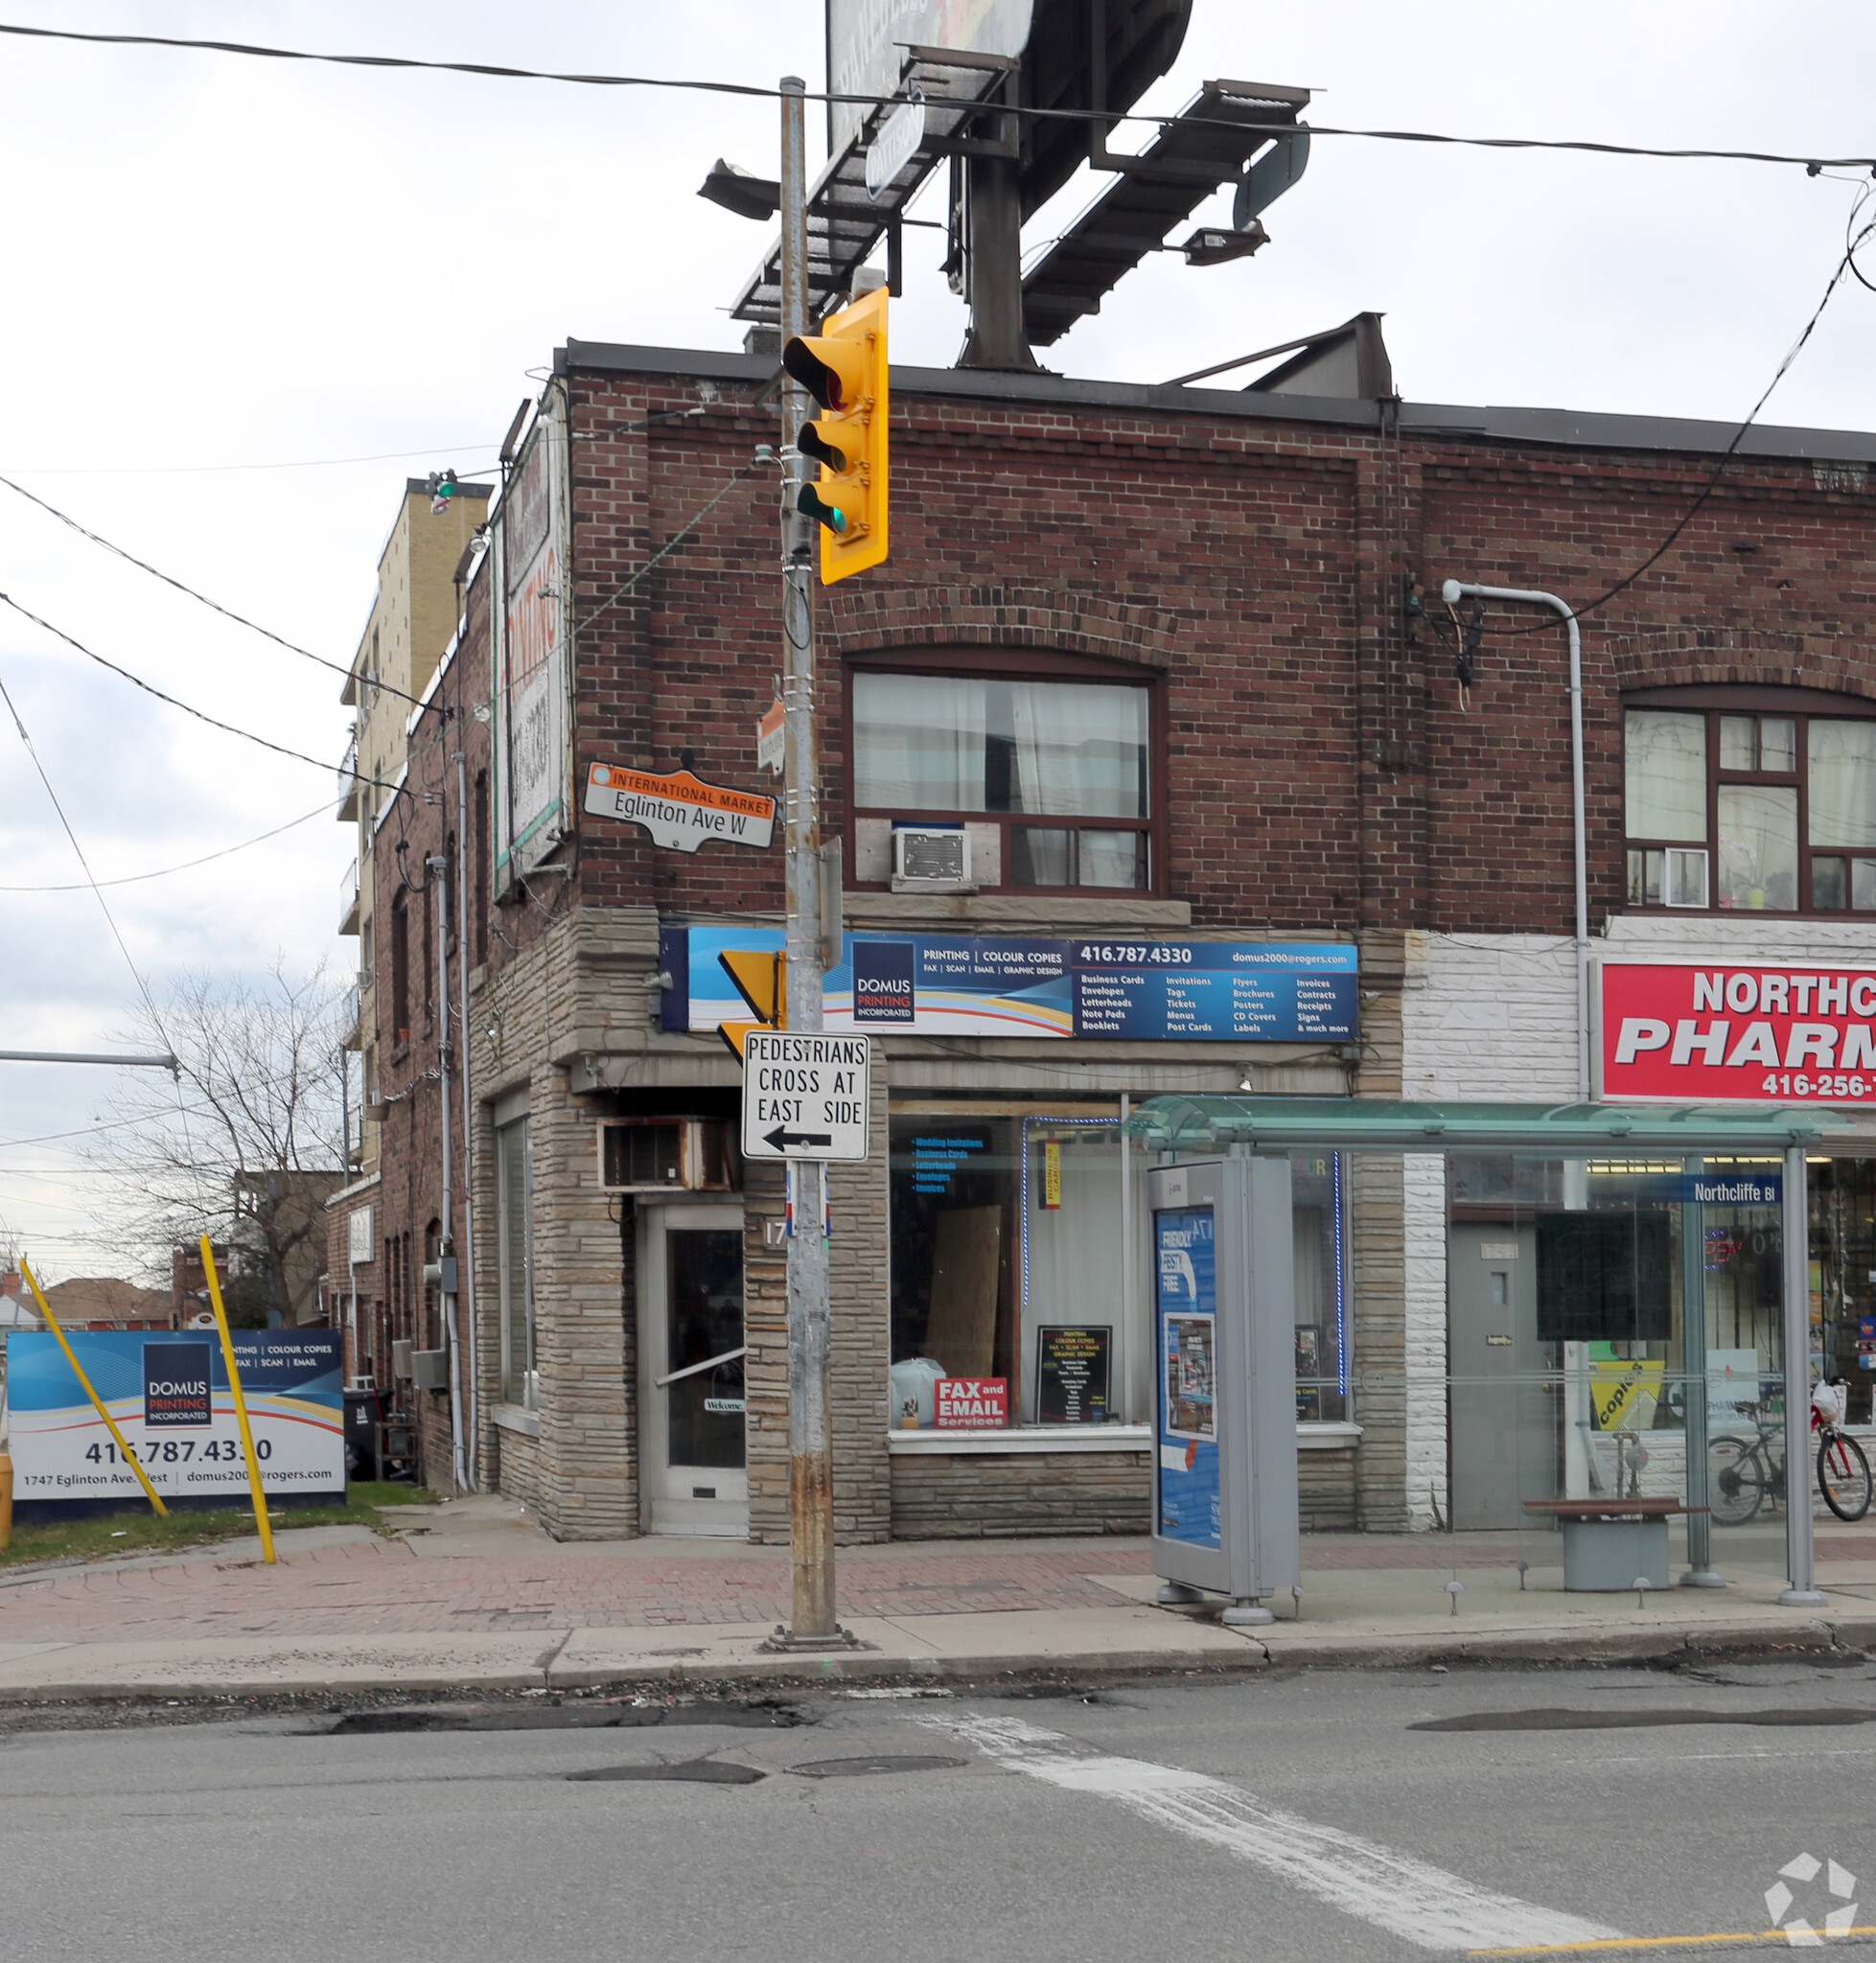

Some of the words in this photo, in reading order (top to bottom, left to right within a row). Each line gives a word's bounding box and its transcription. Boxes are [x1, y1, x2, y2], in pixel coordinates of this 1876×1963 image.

[614, 772, 714, 804] INTERNATIONAL
[720, 795, 771, 815] MARKET
[614, 792, 687, 825] Eglinton
[691, 807, 725, 832] Ave
[731, 815, 747, 836] W
[923, 949, 970, 961] PRINTING
[983, 951, 1025, 963] COLOUR
[1027, 952, 1063, 964] COPIES
[1080, 945, 1193, 963] 416.787.4330
[1232, 952, 1348, 965] domus2000@rogers.com
[923, 963, 938, 972] FAX
[945, 964, 966, 973] SCAN
[974, 965, 996, 974] EMAIL
[1004, 965, 1035, 976] GRAPHIC
[1036, 966, 1063, 976] DESIGN
[1080, 975, 1119, 984] Business
[1121, 976, 1146, 985] Cards
[1166, 977, 1213, 986] Invitations
[1233, 978, 1258, 988] Flyers
[1297, 979, 1331, 988] Invoices
[857, 978, 912, 994] DOMUS
[1081, 986, 1125, 997] Envelopes
[1167, 988, 1187, 999] Tags
[1233, 989, 1275, 999] Brochures
[1297, 990, 1337, 1000] Contracts
[1693, 972, 1876, 1017] NORTHC
[857, 994, 912, 1007] PRINTING
[1081, 998, 1133, 1007] Letterheads
[1167, 1000, 1197, 1009] Tickets
[1234, 1001, 1264, 1010] Posters
[857, 1007, 912, 1017] INCORPORATED
[1297, 1002, 1332, 1012] Receipts
[1082, 1009, 1103, 1019] Note
[1105, 1010, 1126, 1020] Pads
[1167, 1011, 1195, 1021] Menus
[1234, 1012, 1246, 1022] CD
[1248, 1012, 1277, 1022] Covers
[1298, 1013, 1321, 1024] Signs
[1082, 1021, 1120, 1030] Booklets
[1167, 1023, 1186, 1032] Post
[1188, 1023, 1213, 1032] Cards
[1234, 1024, 1262, 1033] Labels
[1298, 1025, 1305, 1033] &
[1307, 1024, 1328, 1033] much
[749, 1037, 866, 1066] PEDESTRIANS
[759, 1068, 820, 1093] CROSS
[833, 1071, 856, 1095] AT
[758, 1098, 802, 1122] EAST
[823, 1100, 862, 1124] SIDE
[1694, 1183, 1761, 1202] Northcliffe
[267, 1345, 302, 1354] COLOUR
[303, 1345, 333, 1354] COPIES
[236, 1358, 251, 1368] FAX
[260, 1358, 284, 1367] SCAN
[292, 1357, 317, 1367] EMAIL
[149, 1381, 207, 1396] DOMUS
[939, 1381, 981, 1399] FAX
[983, 1385, 1004, 1395] and
[1600, 1362, 1643, 1425] copies
[149, 1397, 207, 1410] PRINTING
[939, 1400, 1004, 1417] EMAIL
[149, 1411, 208, 1420] INCORPORATED
[938, 1418, 1003, 1426] Services
[24, 1475, 53, 1486] 1747
[57, 1473, 107, 1488] Eglinton
[110, 1473, 136, 1484] Ave.
